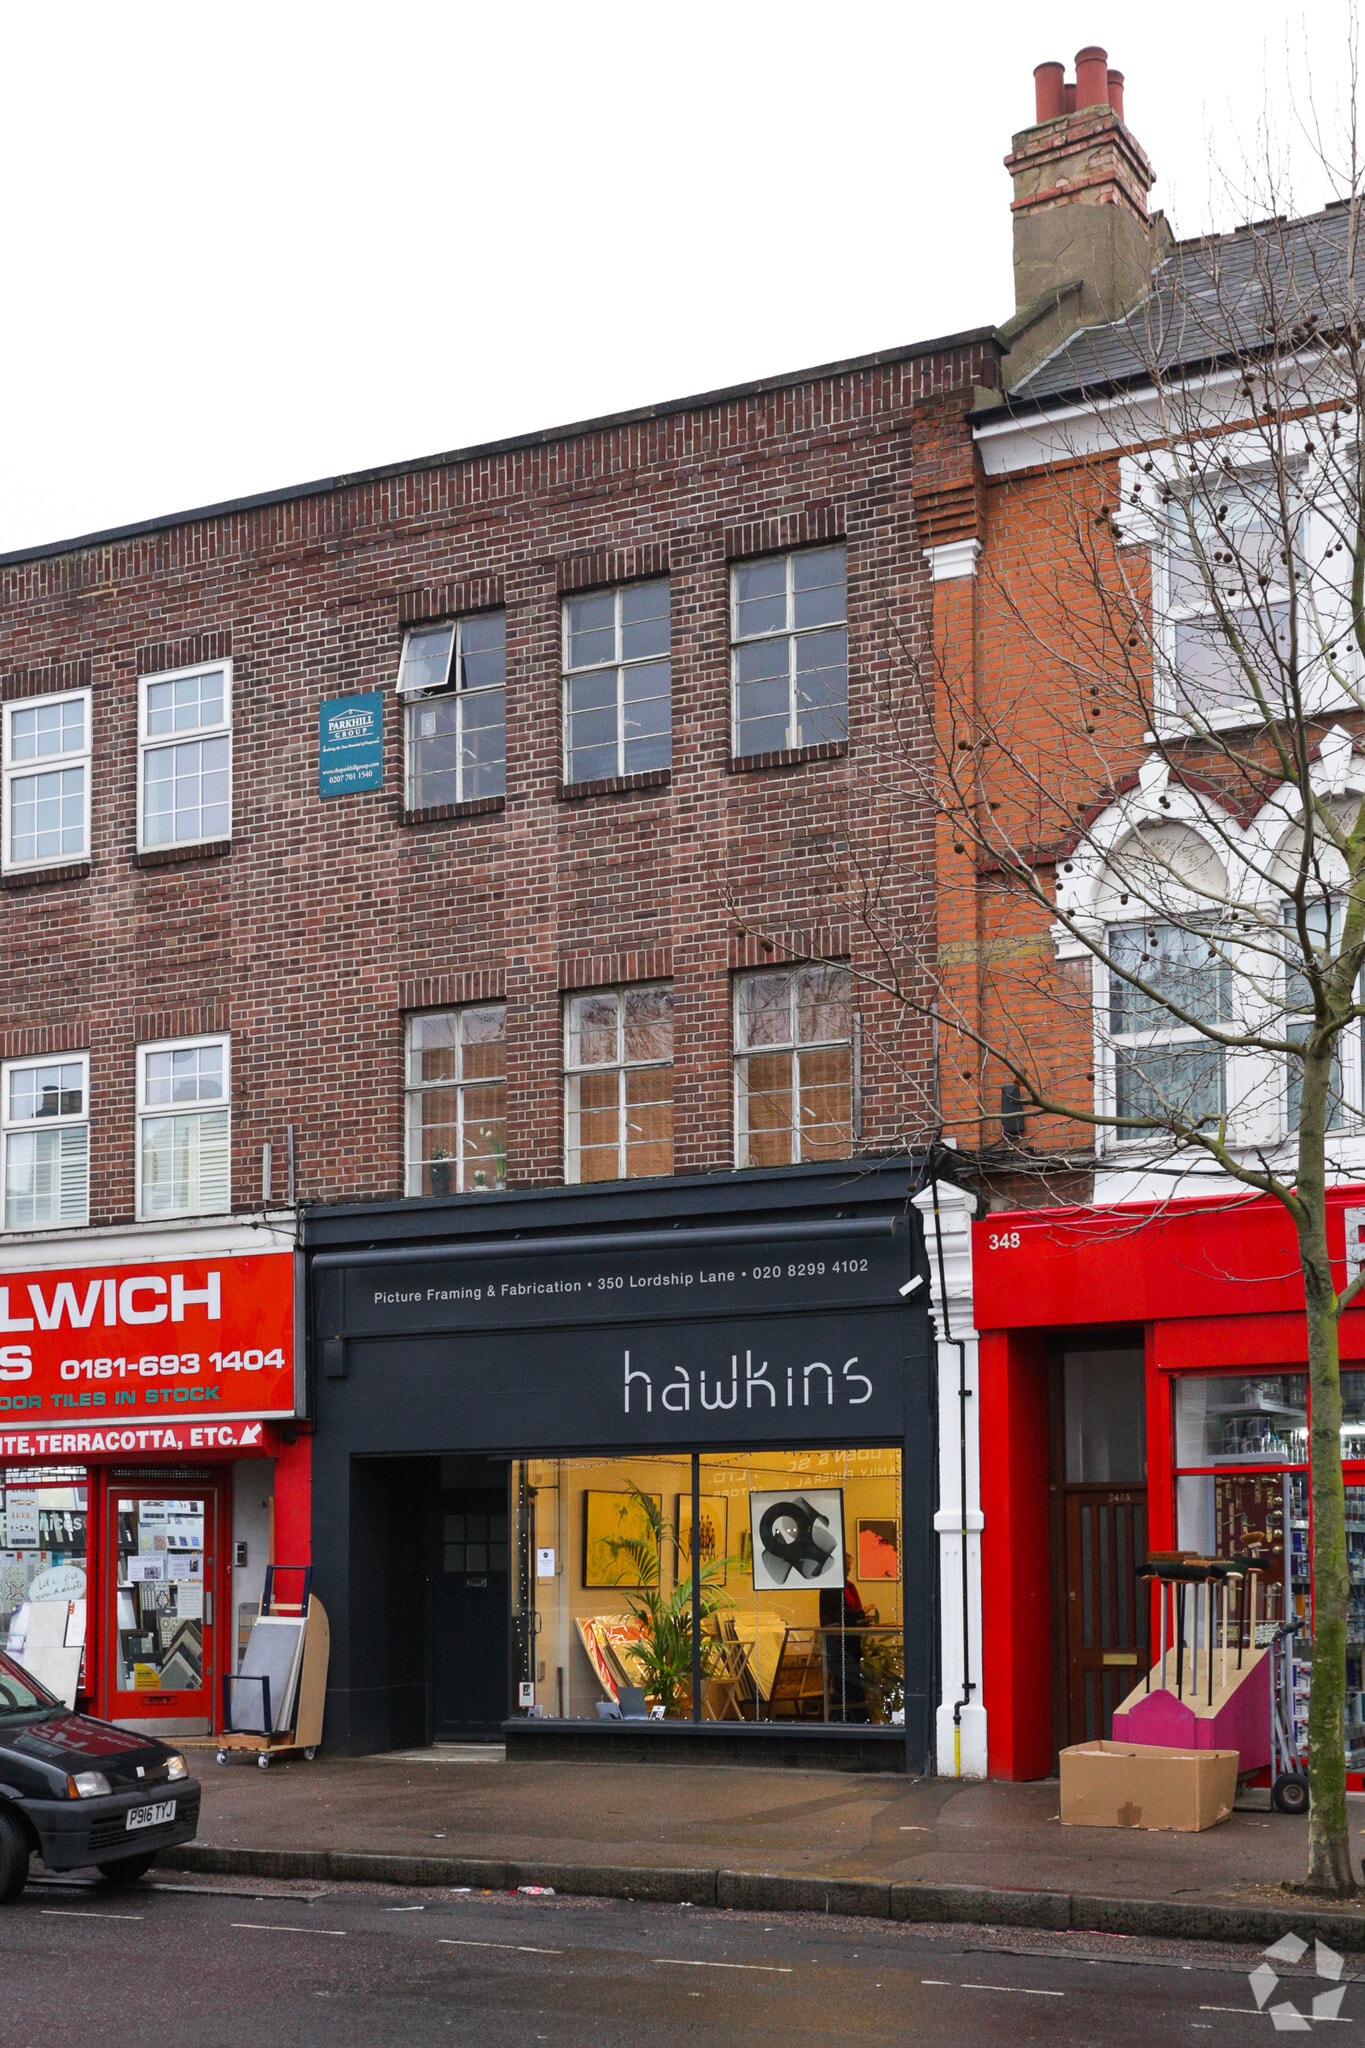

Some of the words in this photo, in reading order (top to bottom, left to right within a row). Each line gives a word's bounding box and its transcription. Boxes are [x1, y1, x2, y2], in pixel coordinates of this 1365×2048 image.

[328, 715, 374, 732] PARKHILL
[335, 727, 368, 739] GROUP
[329, 774, 344, 784] 0207
[345, 773, 356, 781] 701
[358, 770, 373, 779] 1540
[988, 1231, 1021, 1251] 348
[374, 1291, 422, 1304] Picture
[427, 1286, 482, 1301] Framing
[487, 1285, 496, 1297] &
[501, 1280, 582, 1296] Fabrication
[598, 1277, 624, 1290] 350
[630, 1272, 694, 1288] Lordship
[700, 1270, 736, 1284] Lane
[753, 1265, 782, 1280] 020
[787, 1262, 826, 1277] 8299
[832, 1259, 869, 1273] 4102
[60, 1353, 200, 1381] 0181-693
[208, 1349, 285, 1373] 1404
[624, 1350, 874, 1414] hawkins
[52, 1391, 106, 1407] TILES
[115, 1390, 136, 1405] IN
[145, 1386, 221, 1404] STOCK
[190, 1425, 238, 1446] ETC.
[129, 1807, 154, 1826] P916
[156, 1801, 174, 1820] TYJ
